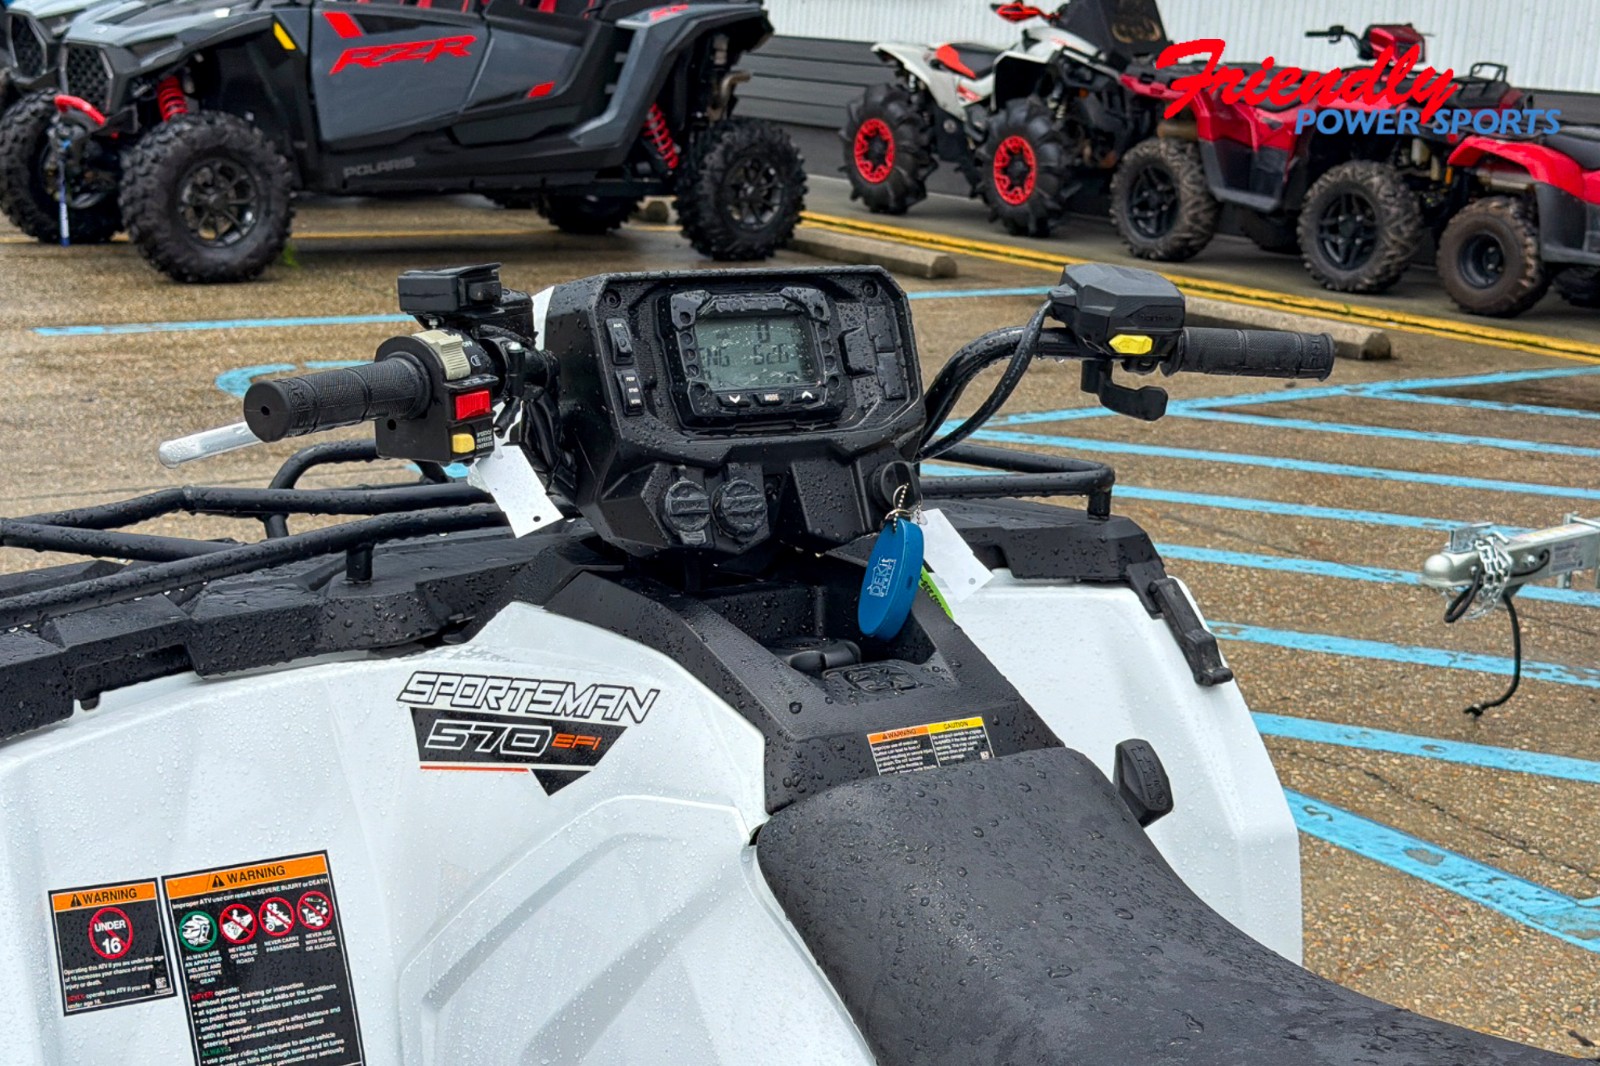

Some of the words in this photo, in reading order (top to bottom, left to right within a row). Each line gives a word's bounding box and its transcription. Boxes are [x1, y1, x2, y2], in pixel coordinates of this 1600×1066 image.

[329, 34, 477, 75] RZR
[342, 156, 416, 179] POLARIS
[396, 670, 660, 724] SPORTSMAN
[943, 721, 969, 729] CAUTION
[424, 718, 553, 757] 570
[551, 732, 602, 750] EFI
[887, 728, 917, 739] WARNING
[227, 866, 285, 884] WARNING
[83, 888, 137, 904] WARNING
[172, 900, 198, 910] Improper
[257, 886, 280, 895] SEVERE
[281, 883, 301, 891] INJURY
[309, 878, 329, 886] DEATH
[94, 920, 126, 932] UNDER
[102, 937, 122, 954] 16
[266, 942, 300, 952] PASSENGERS
[314, 942, 337, 950] ALCOHOL
[186, 952, 208, 961] ALWAYS
[194, 957, 222, 966] APPROVED
[236, 957, 255, 965] ROADS
[189, 970, 222, 980] PROTECTIVE
[200, 977, 215, 985] GEAR
[197, 999, 219, 1007] without
[221, 995, 240, 1003] proper
[242, 990, 264, 999] training
[273, 982, 304, 992] instruction
[307, 984, 337, 994] conditions
[256, 1003, 281, 1012] collision
[201, 1023, 224, 1032] another
[225, 1018, 247, 1027] vehicle
[222, 1026, 252, 1037] passenger
[257, 1018, 290, 1030] passengers
[307, 1009, 329, 1018] balance
[203, 1039, 228, 1049] steering
[241, 1031, 266, 1040] increase
[304, 1018, 324, 1027] control
[219, 1053, 240, 1062] proper
[240, 1049, 258, 1058] riding
[259, 1041, 291, 1054] techniques
[316, 1032, 336, 1041] vehicle
[319, 1046, 345, 1057] seriously
[273, 1050, 291, 1059] rough
